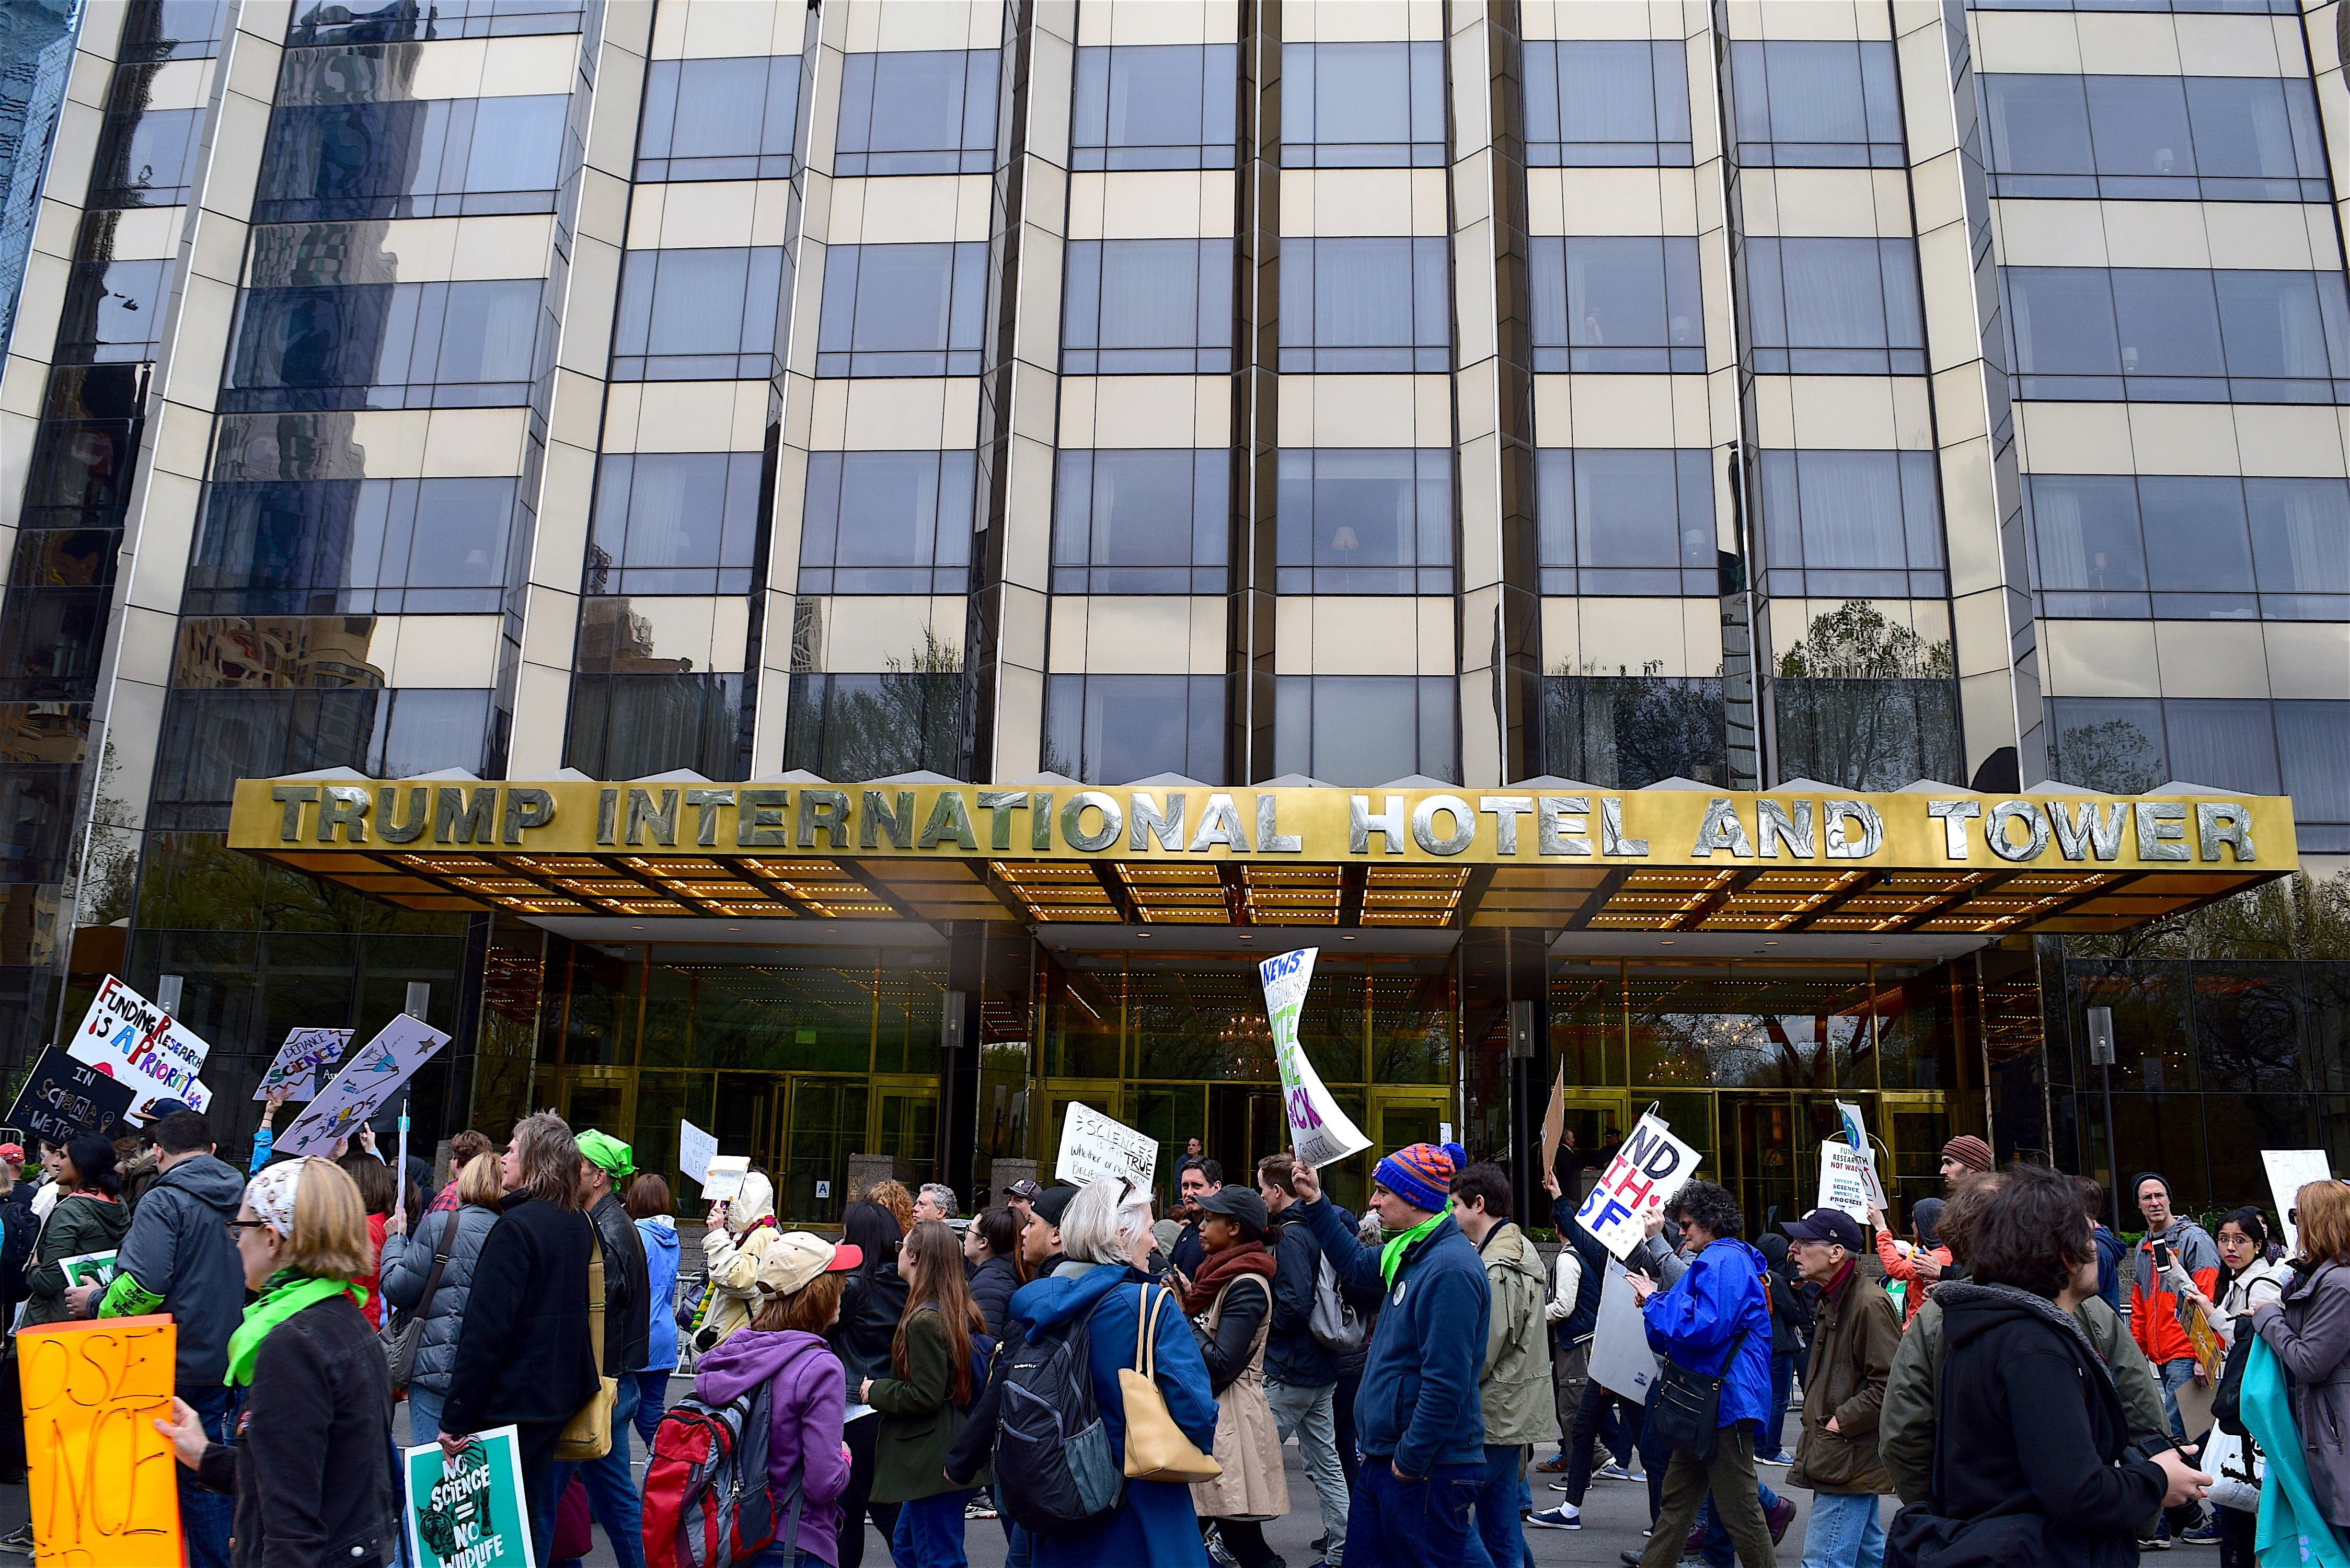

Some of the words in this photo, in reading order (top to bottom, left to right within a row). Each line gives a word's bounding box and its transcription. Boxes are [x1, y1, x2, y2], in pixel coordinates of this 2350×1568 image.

[272, 787, 557, 844] TRUMP
[597, 788, 1302, 852] INTERNATIONAL
[1350, 794, 1648, 856] HOTEL
[1691, 798, 1883, 859] AND
[1927, 800, 2256, 861] TOWER
[110, 1025, 135, 1054] A
[151, 1016, 203, 1069] RESEARCH
[284, 1033, 326, 1058] DEFIANCE
[72, 1067, 96, 1087] IN
[30, 1111, 52, 1132] WE
[1075, 1104, 1092, 1116] THE
[1095, 1114, 1112, 1125] GOOD
[1114, 1123, 1135, 1138] THING
[1138, 1136, 1157, 1150] ABOUT
[684, 1123, 715, 1154] SCIENCE
[1087, 1121, 1146, 1157] SCIENCE
[1622, 1122, 1679, 1179] ND
[693, 1149, 702, 1158] NOT
[1097, 1139, 1103, 1149] is
[1109, 1143, 1115, 1152] it
[1116, 1148, 1122, 1157] is
[1124, 1151, 1153, 1175] TRUE
[1831, 1161, 1843, 1170] NOT
[1833, 1154, 1855, 1163] RESEAR
[2270, 1152, 2324, 1174] FACTS
[1073, 1161, 1105, 1179] BELIEV
[1114, 1165, 1127, 1175] not
[1600, 1154, 1654, 1209] IH
[819, 1183, 827, 1193] A
[1830, 1196, 1862, 1206] PROGRESS
[1578, 1188, 1632, 1232] SF
[24, 1400, 169, 1544] NCE
[442, 1455, 467, 1482] NO
[453, 1521, 479, 1550] NO
